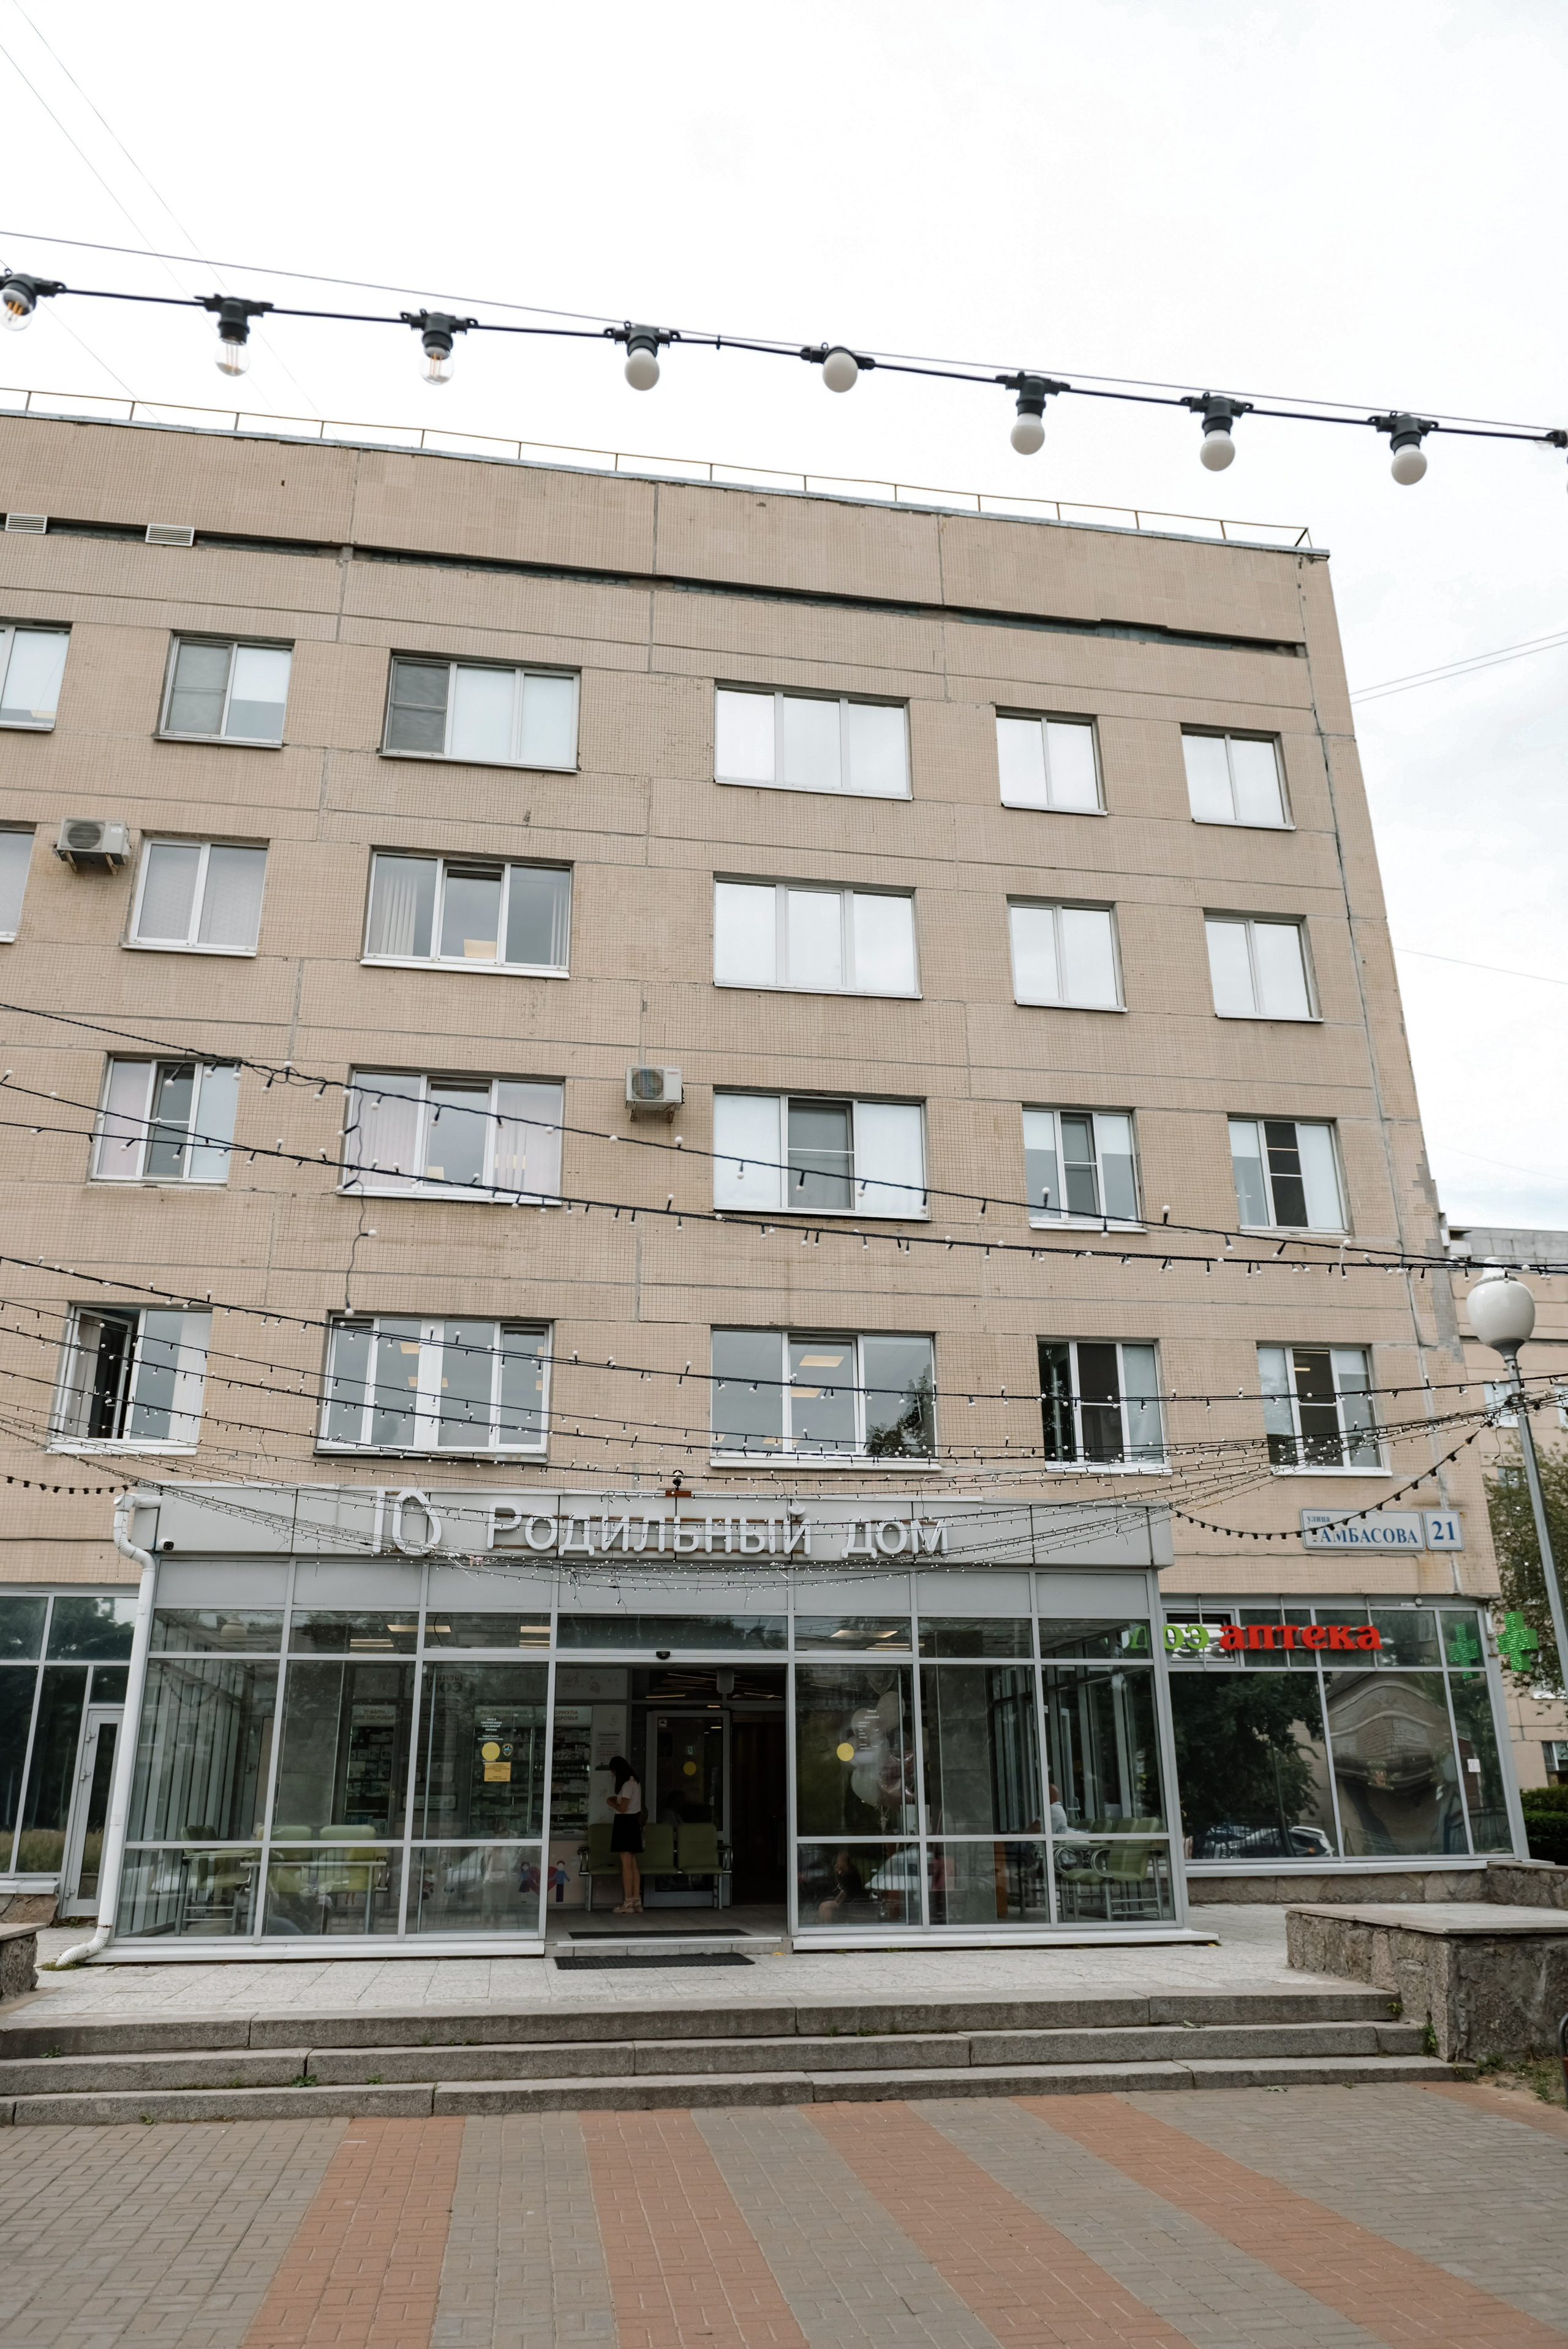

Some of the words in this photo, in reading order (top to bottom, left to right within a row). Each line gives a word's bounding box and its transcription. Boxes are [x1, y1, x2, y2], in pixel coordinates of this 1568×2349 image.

[372, 1489, 442, 1555] 10
[1307, 1515, 1330, 1524] улица
[1312, 1527, 1419, 1544] АМБАСОВА
[1431, 1521, 1457, 1540] 21
[1219, 1625, 1384, 1650] аптека
